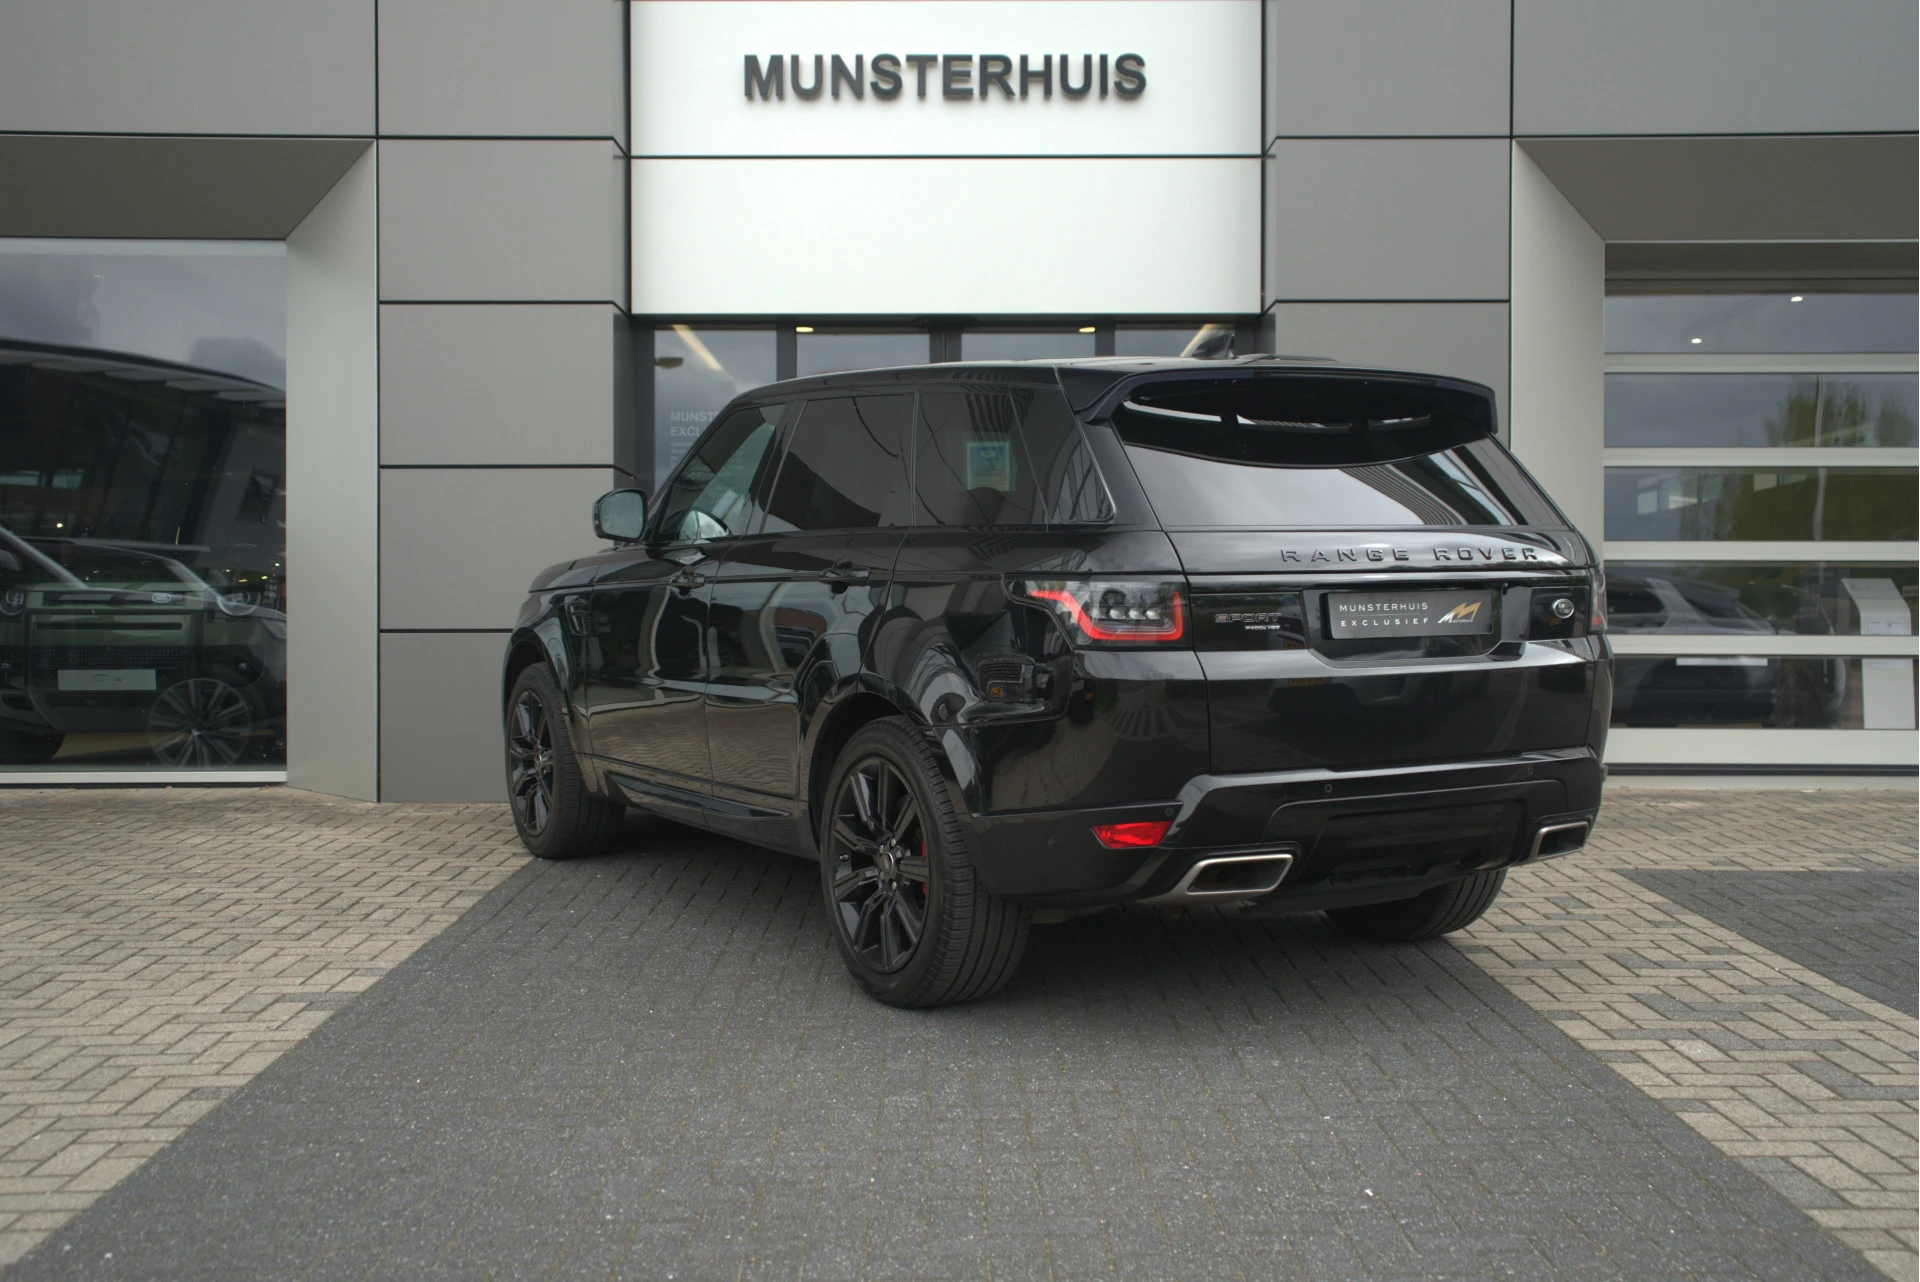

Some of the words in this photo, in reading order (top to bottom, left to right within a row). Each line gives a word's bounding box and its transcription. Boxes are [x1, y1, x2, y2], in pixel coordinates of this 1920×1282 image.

[744, 53, 1147, 99] MUNSTERHUIS
[670, 411, 718, 422] MUNST
[670, 426, 706, 437] EXCL
[1281, 548, 1410, 563] RANGE
[1433, 547, 1538, 561] ROVER
[1339, 602, 1429, 612] MUNSTERHUIS
[1215, 612, 1281, 623] SPORT
[1340, 617, 1429, 627] EXCLUSIEF
